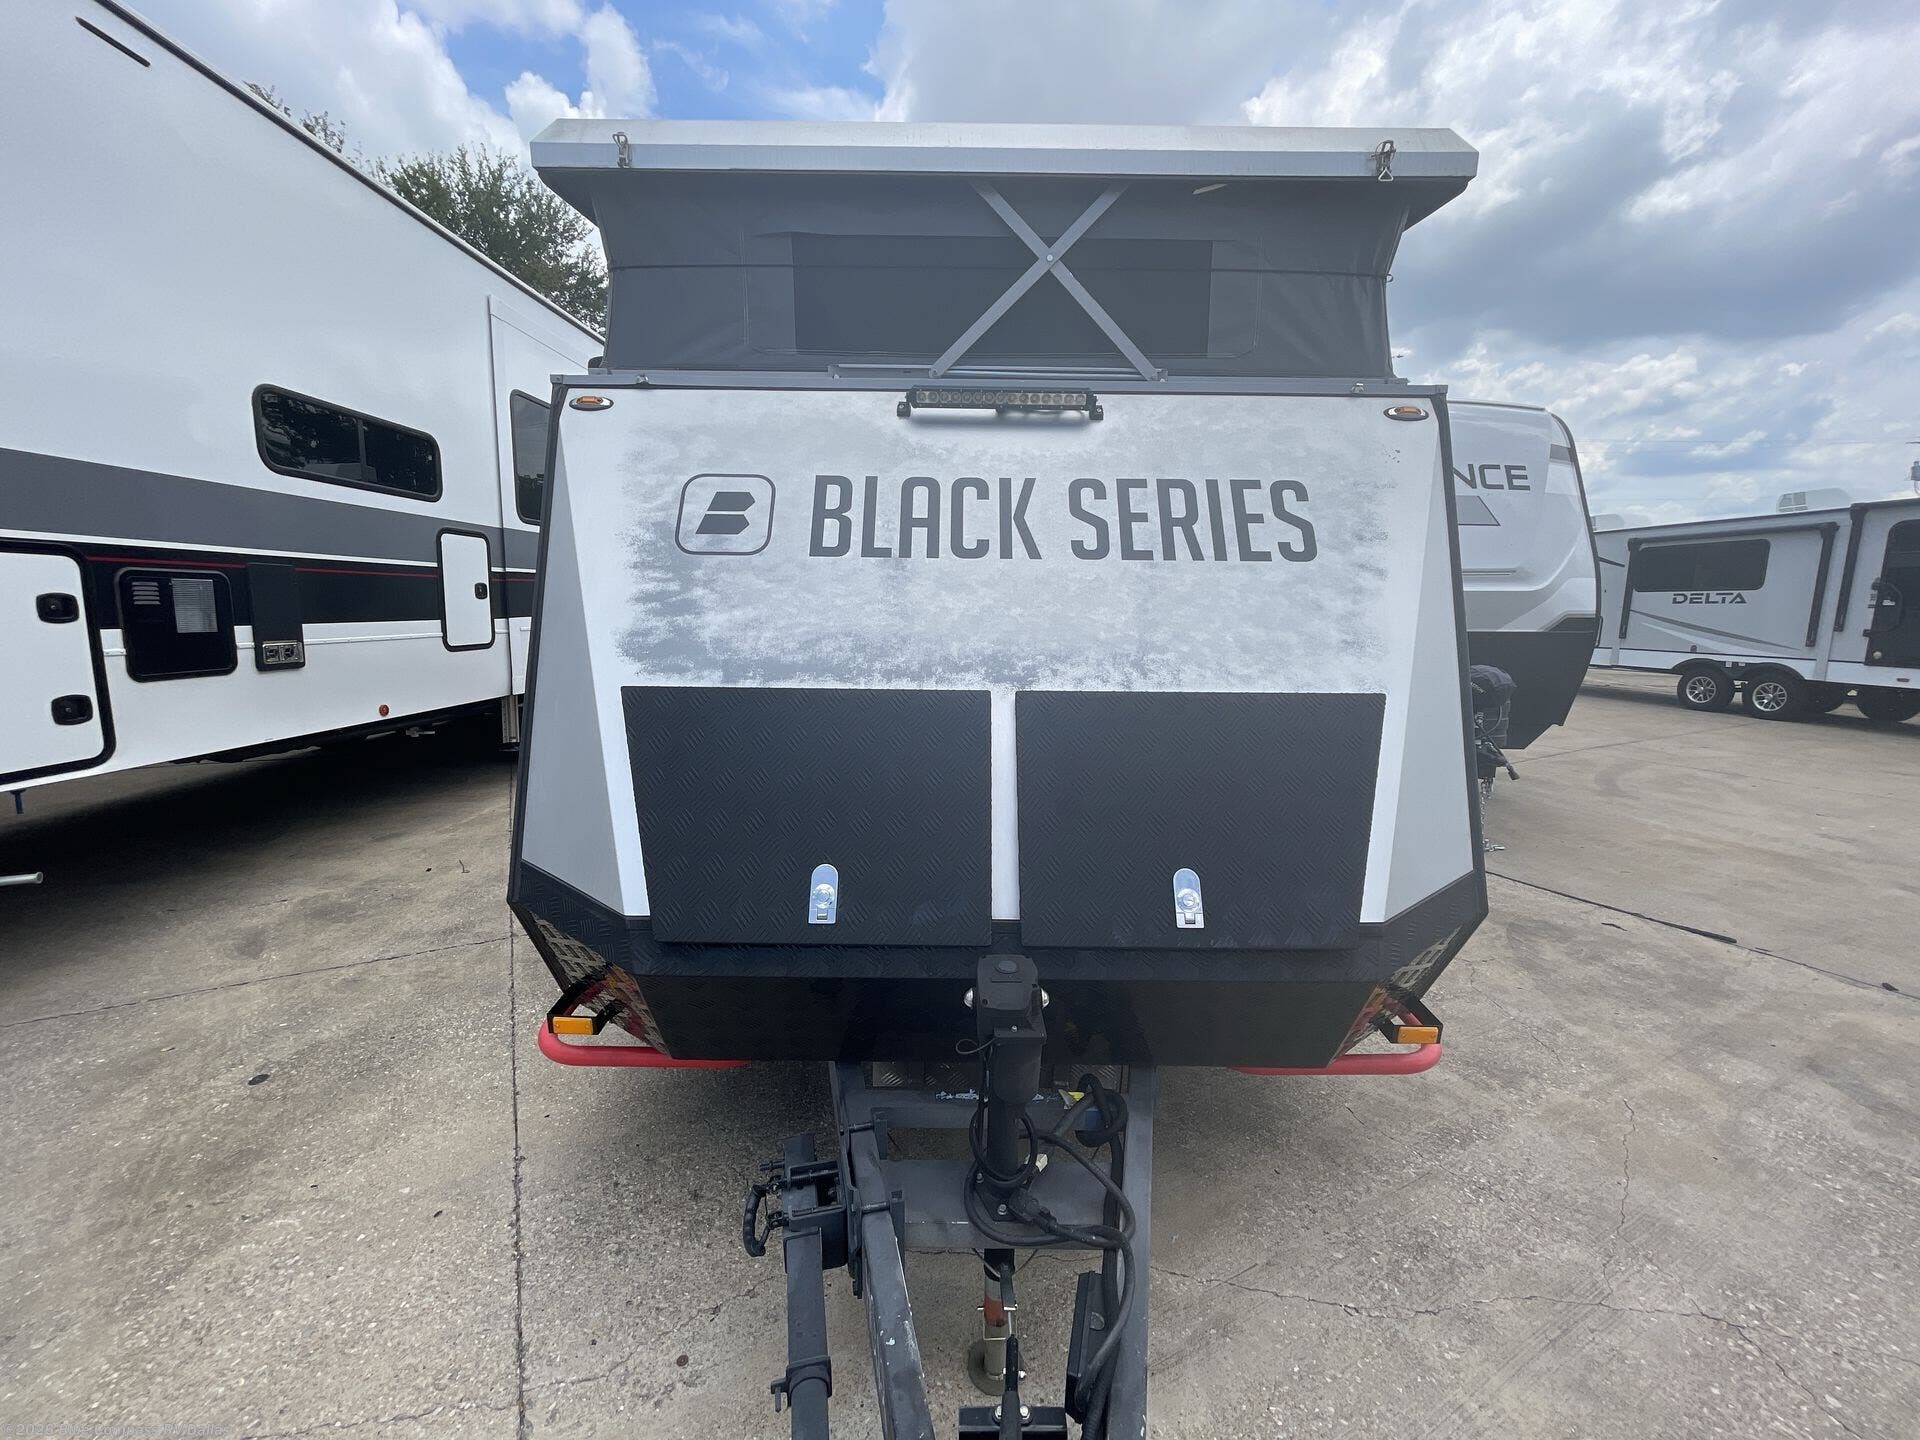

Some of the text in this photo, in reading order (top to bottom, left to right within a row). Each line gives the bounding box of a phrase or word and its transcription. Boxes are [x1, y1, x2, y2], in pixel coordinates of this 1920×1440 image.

[809, 475, 1317, 562] BLACK SERIES
[1672, 592, 1747, 604] DELTA
